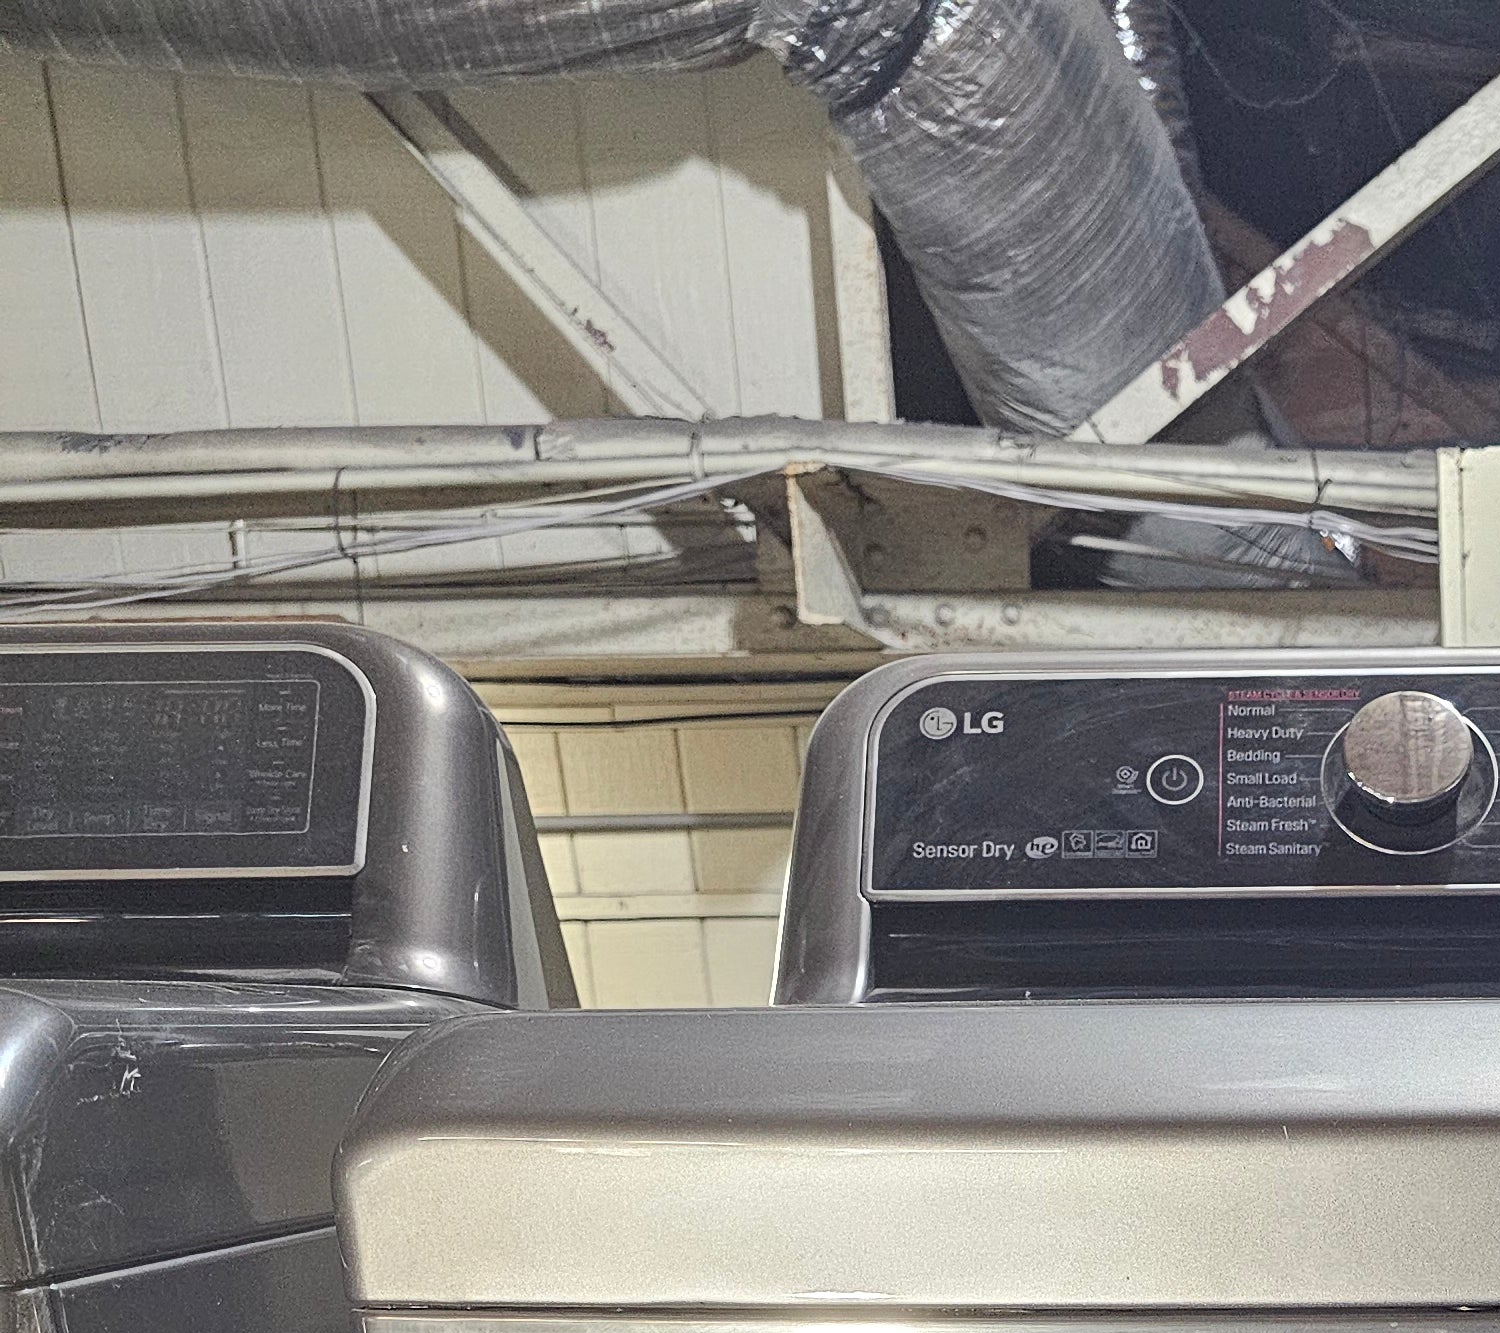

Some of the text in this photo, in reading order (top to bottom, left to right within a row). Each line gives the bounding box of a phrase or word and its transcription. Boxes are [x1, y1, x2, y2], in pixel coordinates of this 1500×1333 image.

[1228, 704, 1275, 716] Normal
[963, 711, 1004, 734] LG
[1227, 726, 1304, 740] Heavy Duty
[1227, 749, 1281, 763] Bedding
[1226, 772, 1297, 785] Small Load
[1227, 795, 1317, 809] Anti-Bacterial
[1226, 819, 1269, 832] Steam
[912, 841, 1015, 861] Sensor Dry
[1225, 842, 1322, 857] Steam Sanitary
